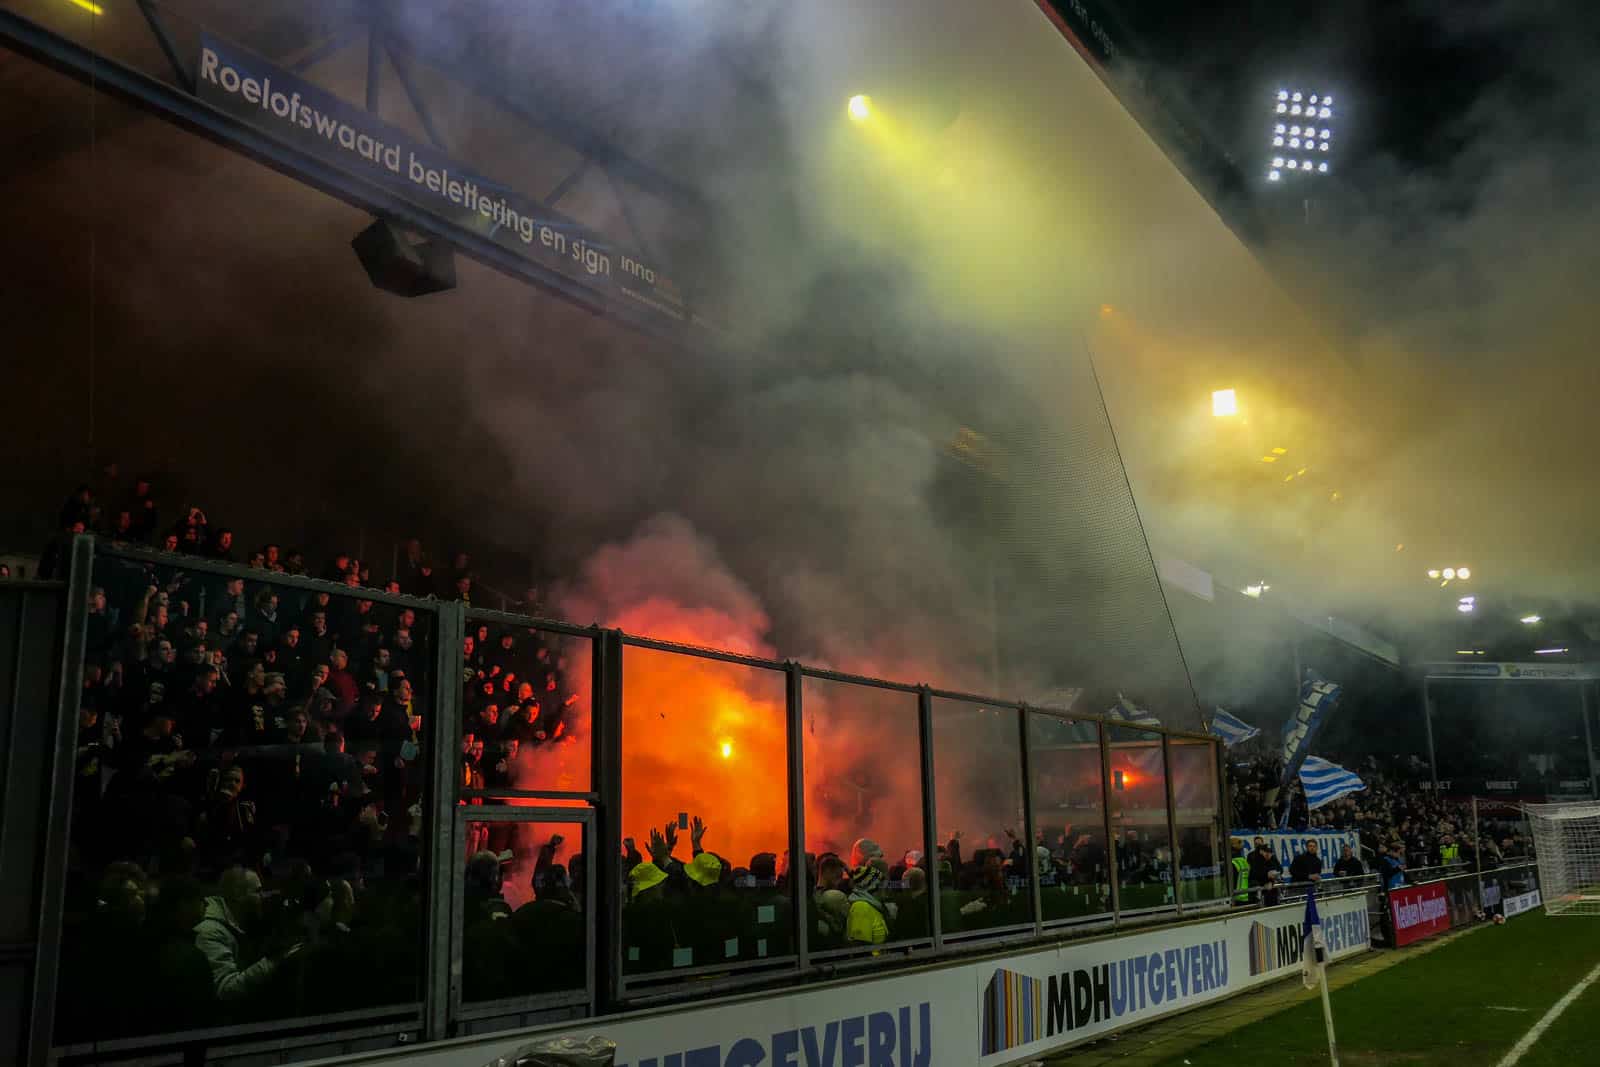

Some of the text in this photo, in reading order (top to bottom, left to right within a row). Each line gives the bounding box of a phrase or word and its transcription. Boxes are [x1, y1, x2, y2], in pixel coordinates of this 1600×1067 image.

[200, 47, 610, 277] Roelofswaard belettering en sign
